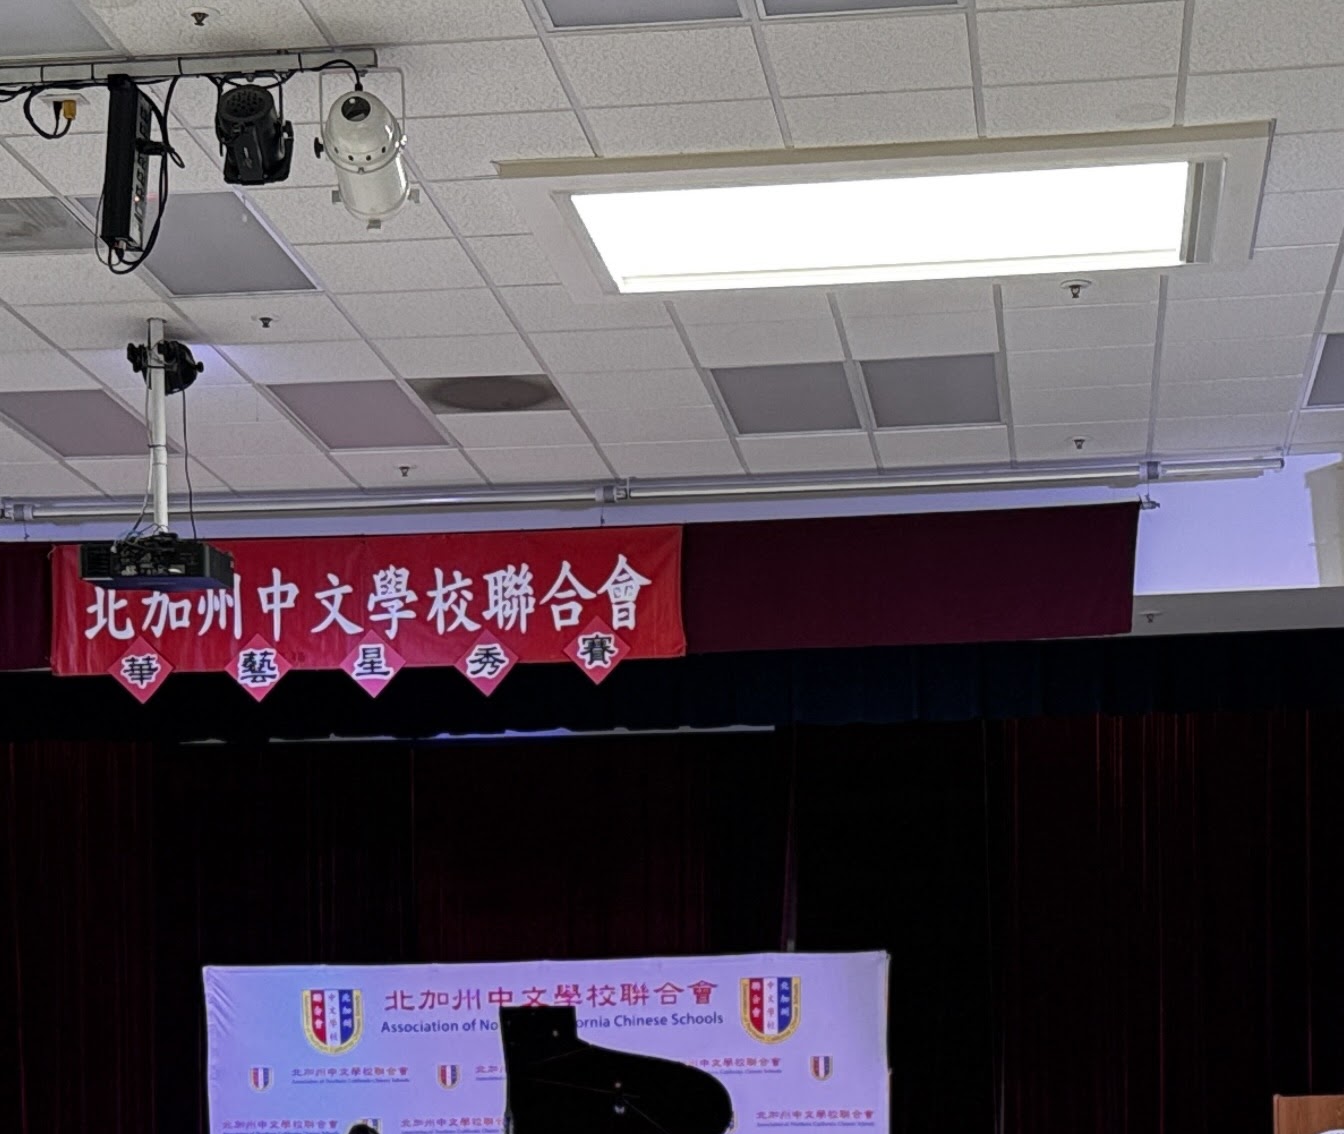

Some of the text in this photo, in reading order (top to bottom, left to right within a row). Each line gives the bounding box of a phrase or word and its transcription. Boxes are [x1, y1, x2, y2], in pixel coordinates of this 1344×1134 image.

[84, 554, 652, 642] 北加州中文學校聯合會
[384, 980, 719, 1012] 北加州中文學校聯合會
[381, 1020, 458, 1033] Association
[462, 1018, 477, 1032] of
[613, 1014, 668, 1028] Chinese
[671, 1011, 724, 1026] Schools
